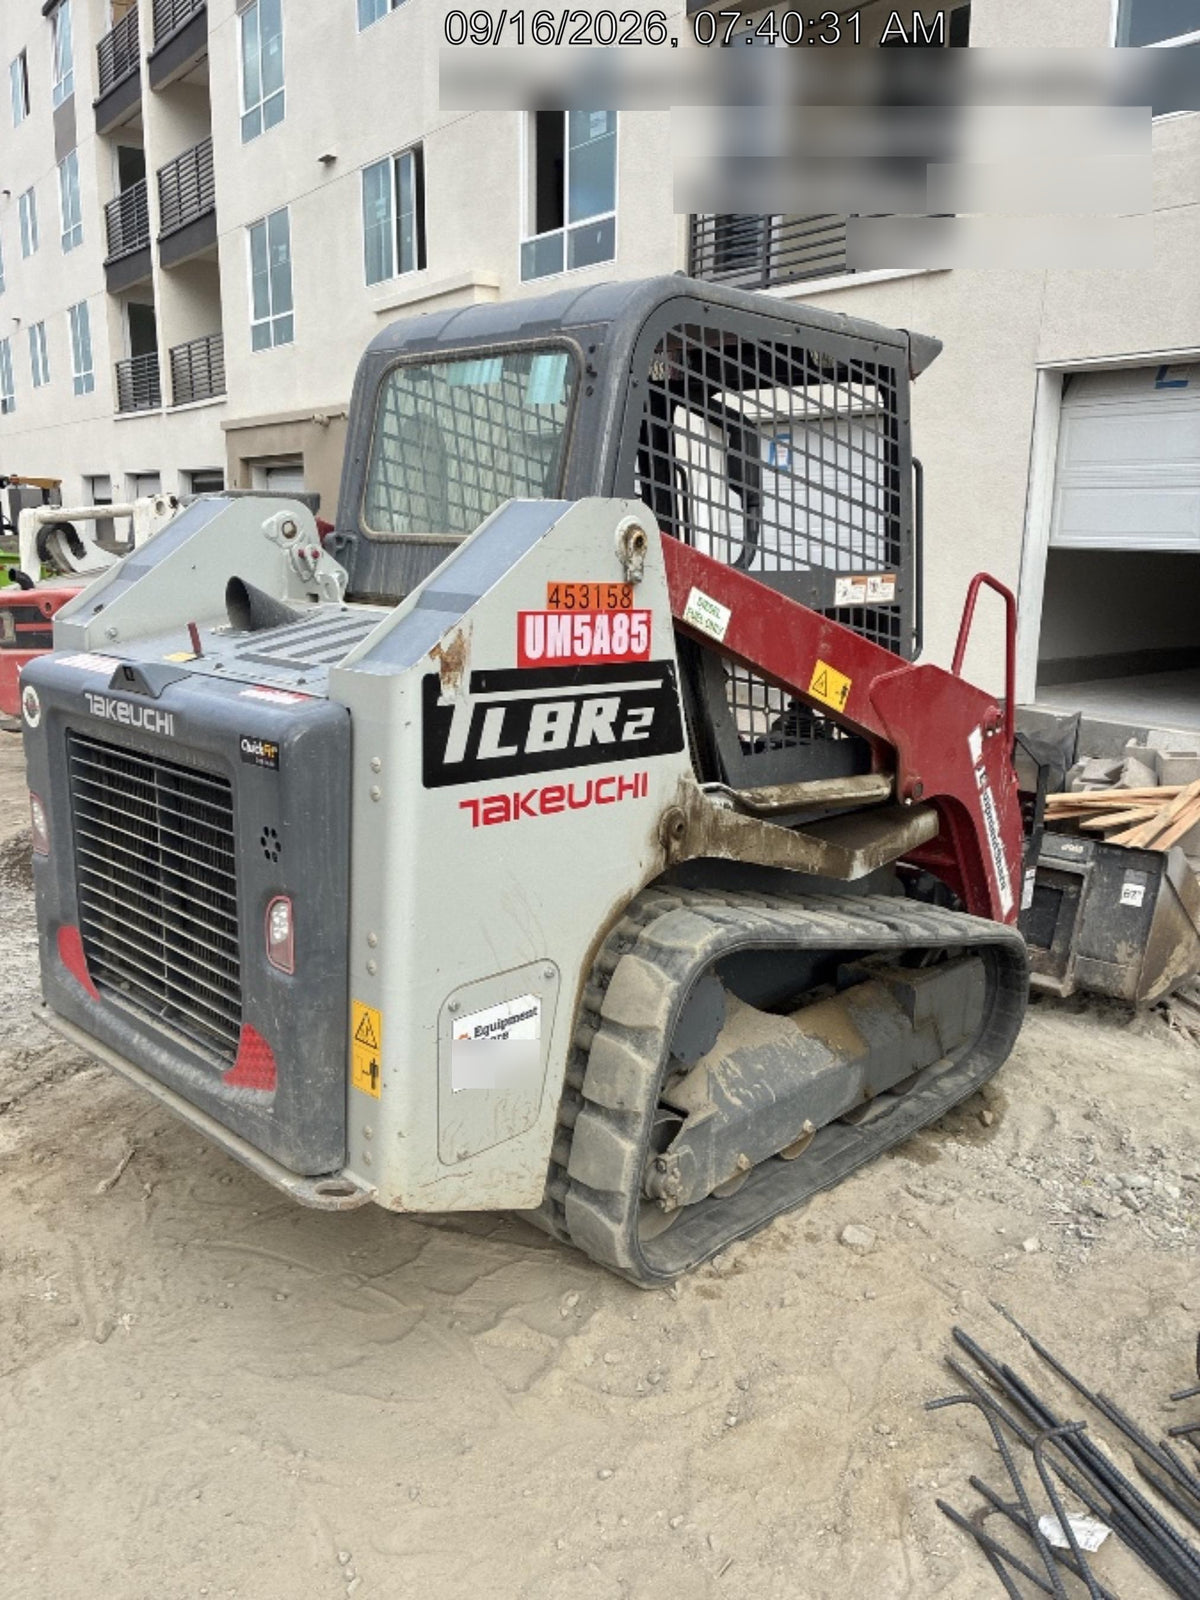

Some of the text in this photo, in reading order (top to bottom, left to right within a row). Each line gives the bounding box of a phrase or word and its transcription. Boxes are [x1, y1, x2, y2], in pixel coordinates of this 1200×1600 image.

[549, 584, 633, 610] 453158
[524, 613, 649, 660] UM5A85
[458, 771, 649, 828] TAKEUCHI
[473, 1006, 538, 1038] Equipment
